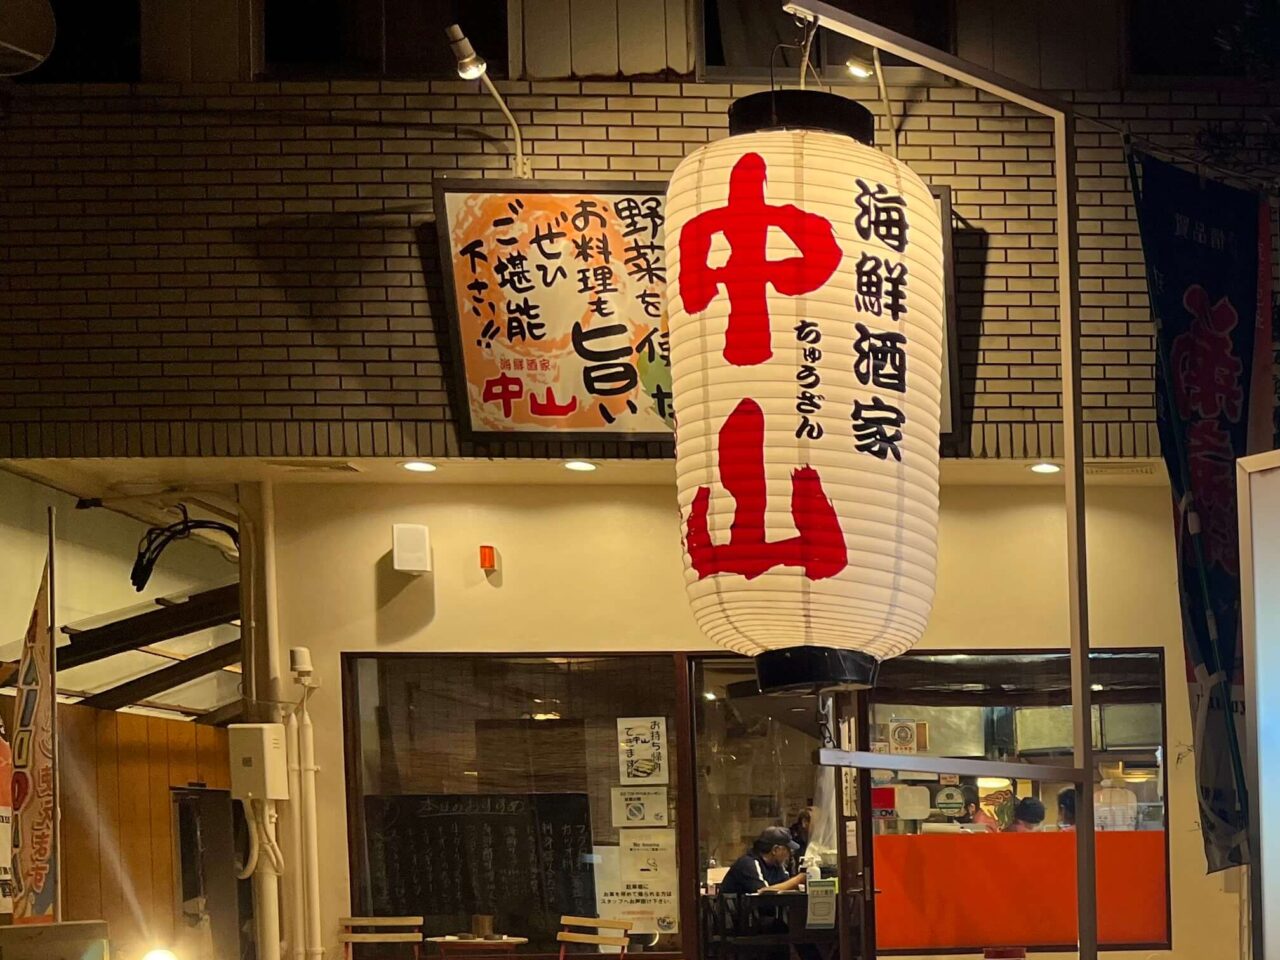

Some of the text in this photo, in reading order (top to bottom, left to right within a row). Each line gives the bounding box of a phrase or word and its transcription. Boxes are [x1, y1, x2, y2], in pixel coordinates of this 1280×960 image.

[493, 198, 547, 343] ご堪能
[529, 211, 568, 287] ぜひ
[571, 200, 638, 424] お料理も旨い
[851, 178, 910, 462] 海鮮酒家
[483, 372, 578, 418] 中山
[678, 151, 849, 581] 中山
[794, 320, 825, 441] ちゅうざん
